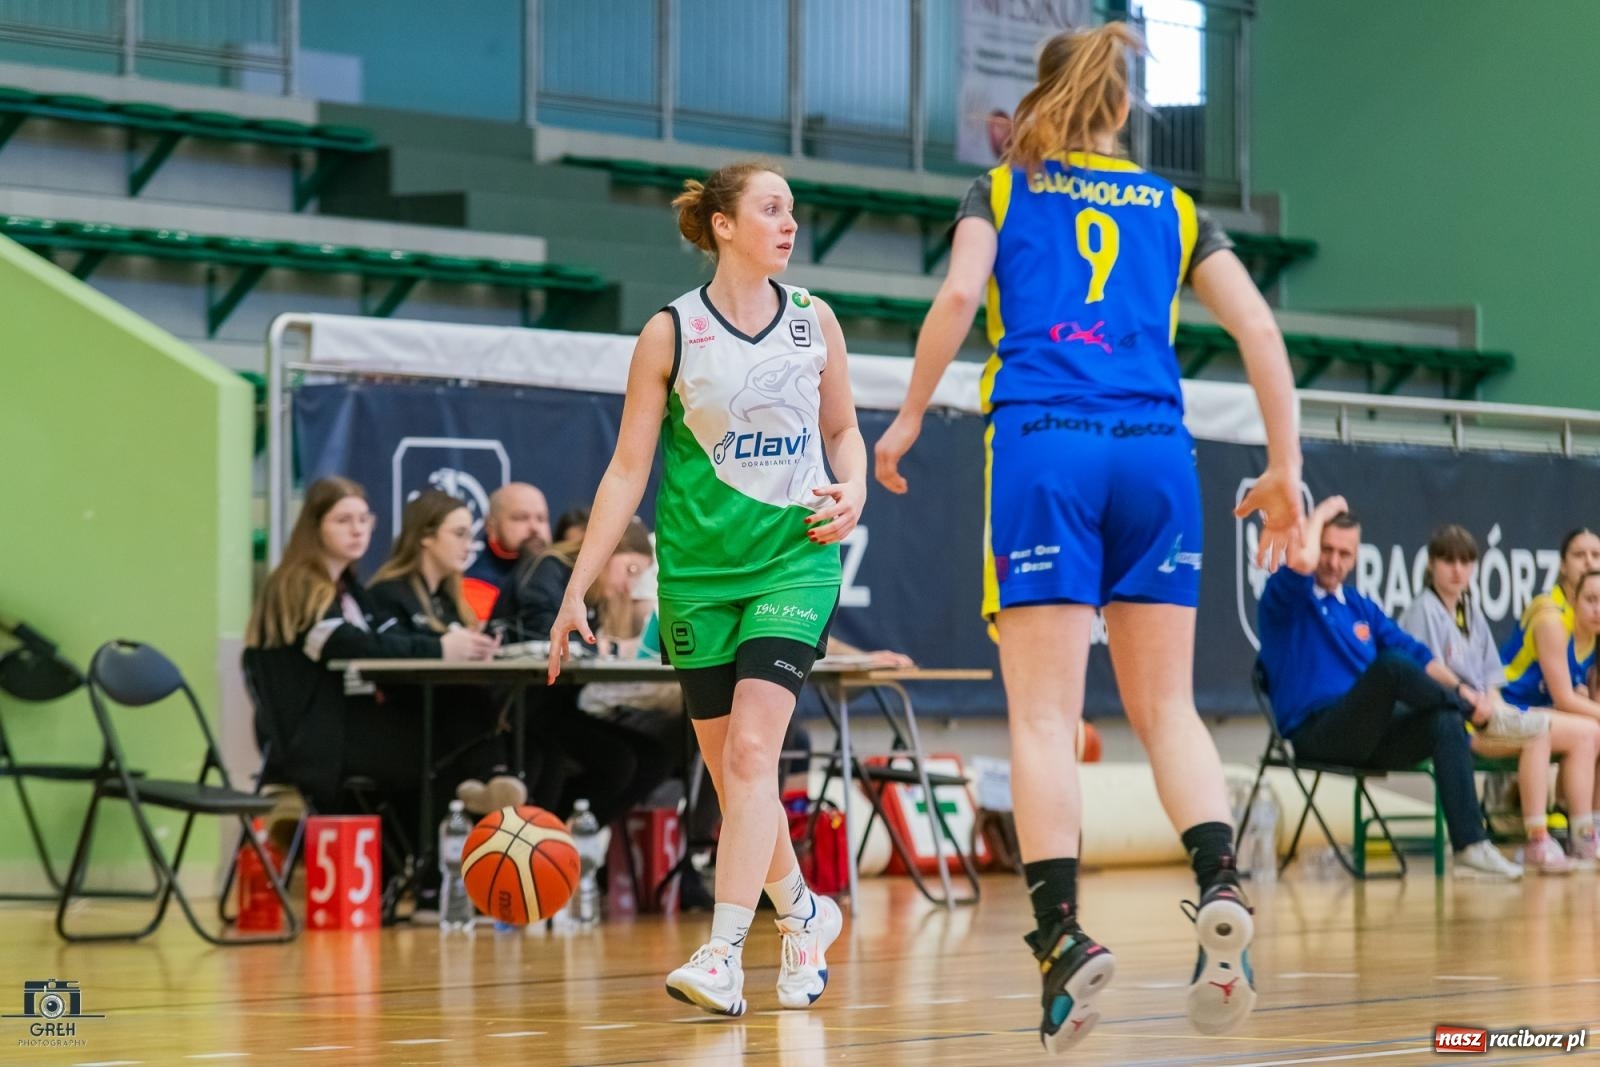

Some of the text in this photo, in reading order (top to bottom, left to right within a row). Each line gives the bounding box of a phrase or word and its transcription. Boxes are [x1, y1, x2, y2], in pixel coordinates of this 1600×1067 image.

[1075, 207, 1120, 304] 9
[790, 319, 811, 347] 9
[735, 427, 811, 459] Clavi
[741, 459, 792, 468] DORABIANIE
[671, 621, 696, 655] 9
[311, 829, 338, 904] 5
[348, 828, 375, 904] 5
